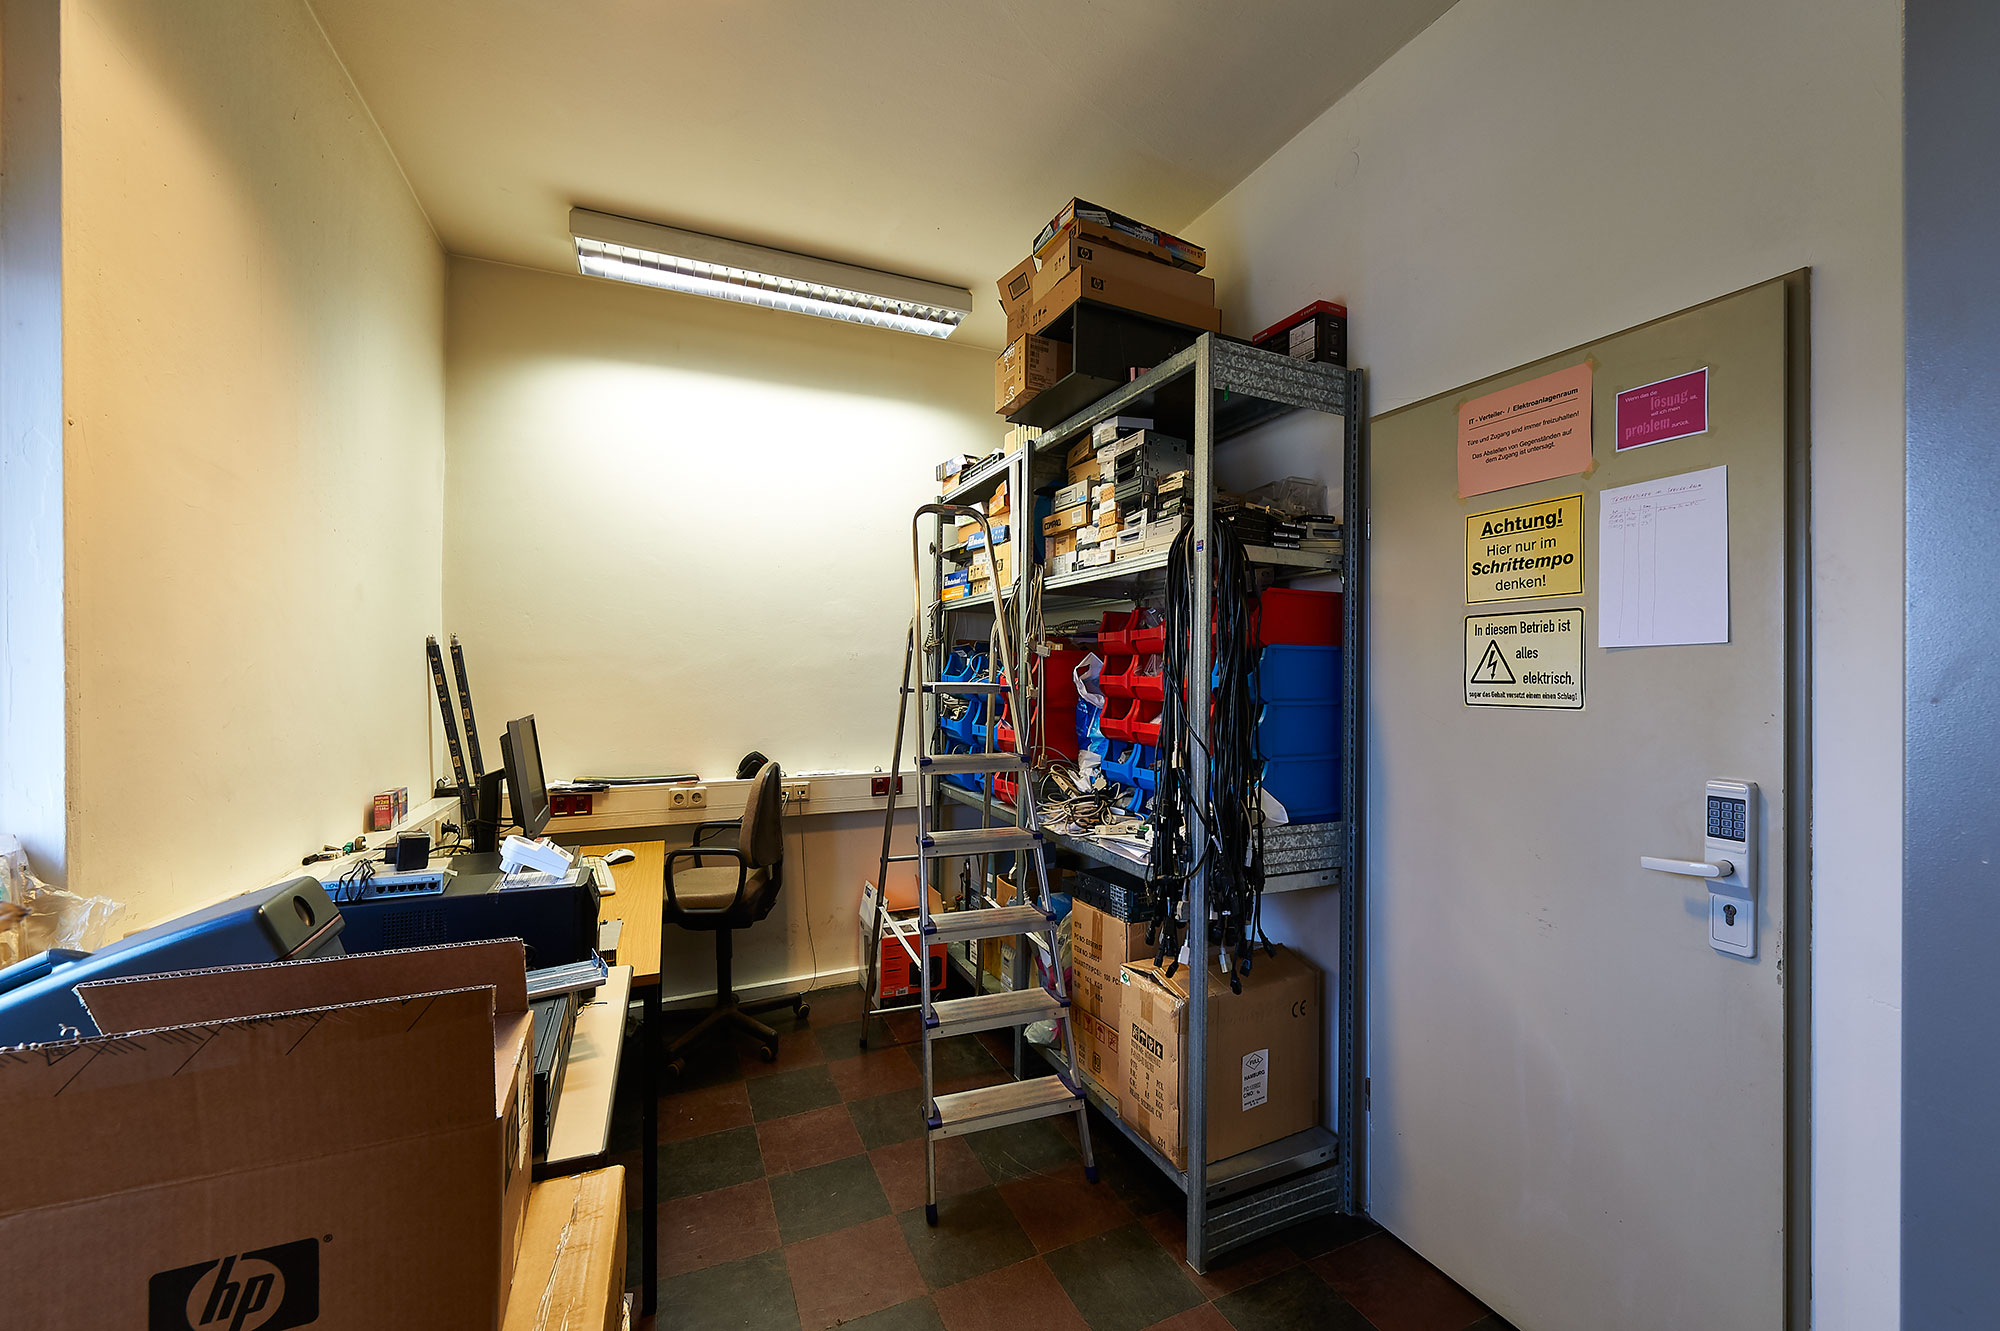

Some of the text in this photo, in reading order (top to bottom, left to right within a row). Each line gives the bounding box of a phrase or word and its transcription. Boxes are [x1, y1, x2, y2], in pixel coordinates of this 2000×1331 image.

[1512, 388, 1578, 412] Elektroanlagenraum
[1650, 390, 1688, 410] lösung
[1490, 430, 1510, 442] Zugang
[1511, 426, 1522, 434] sind
[1524, 421, 1542, 432] immer
[1542, 410, 1580, 426] freizuhalten!
[1626, 418, 1670, 440] problem
[1472, 452, 1482, 460] Das
[1483, 445, 1508, 457] Abstellen
[1519, 432, 1561, 448] Gegenständen
[1562, 428, 1572, 436] auf
[1486, 455, 1498, 464] dem
[1498, 450, 1518, 461] Zugang
[1527, 442, 1555, 454] untersagt.
[1481, 508, 1562, 536] Achtung!
[1487, 537, 1556, 556] Hier nur im
[1472, 553, 1574, 576] Schrittempo
[1496, 574, 1546, 591] denken!
[1474, 618, 1570, 636] In diesem Betrieb ist
[1516, 646, 1538, 658] alles
[1522, 671, 1574, 686] elektrisch,
[1244, 1070, 1266, 1081] HAMBURG
[199, 1254, 274, 1331] hp
